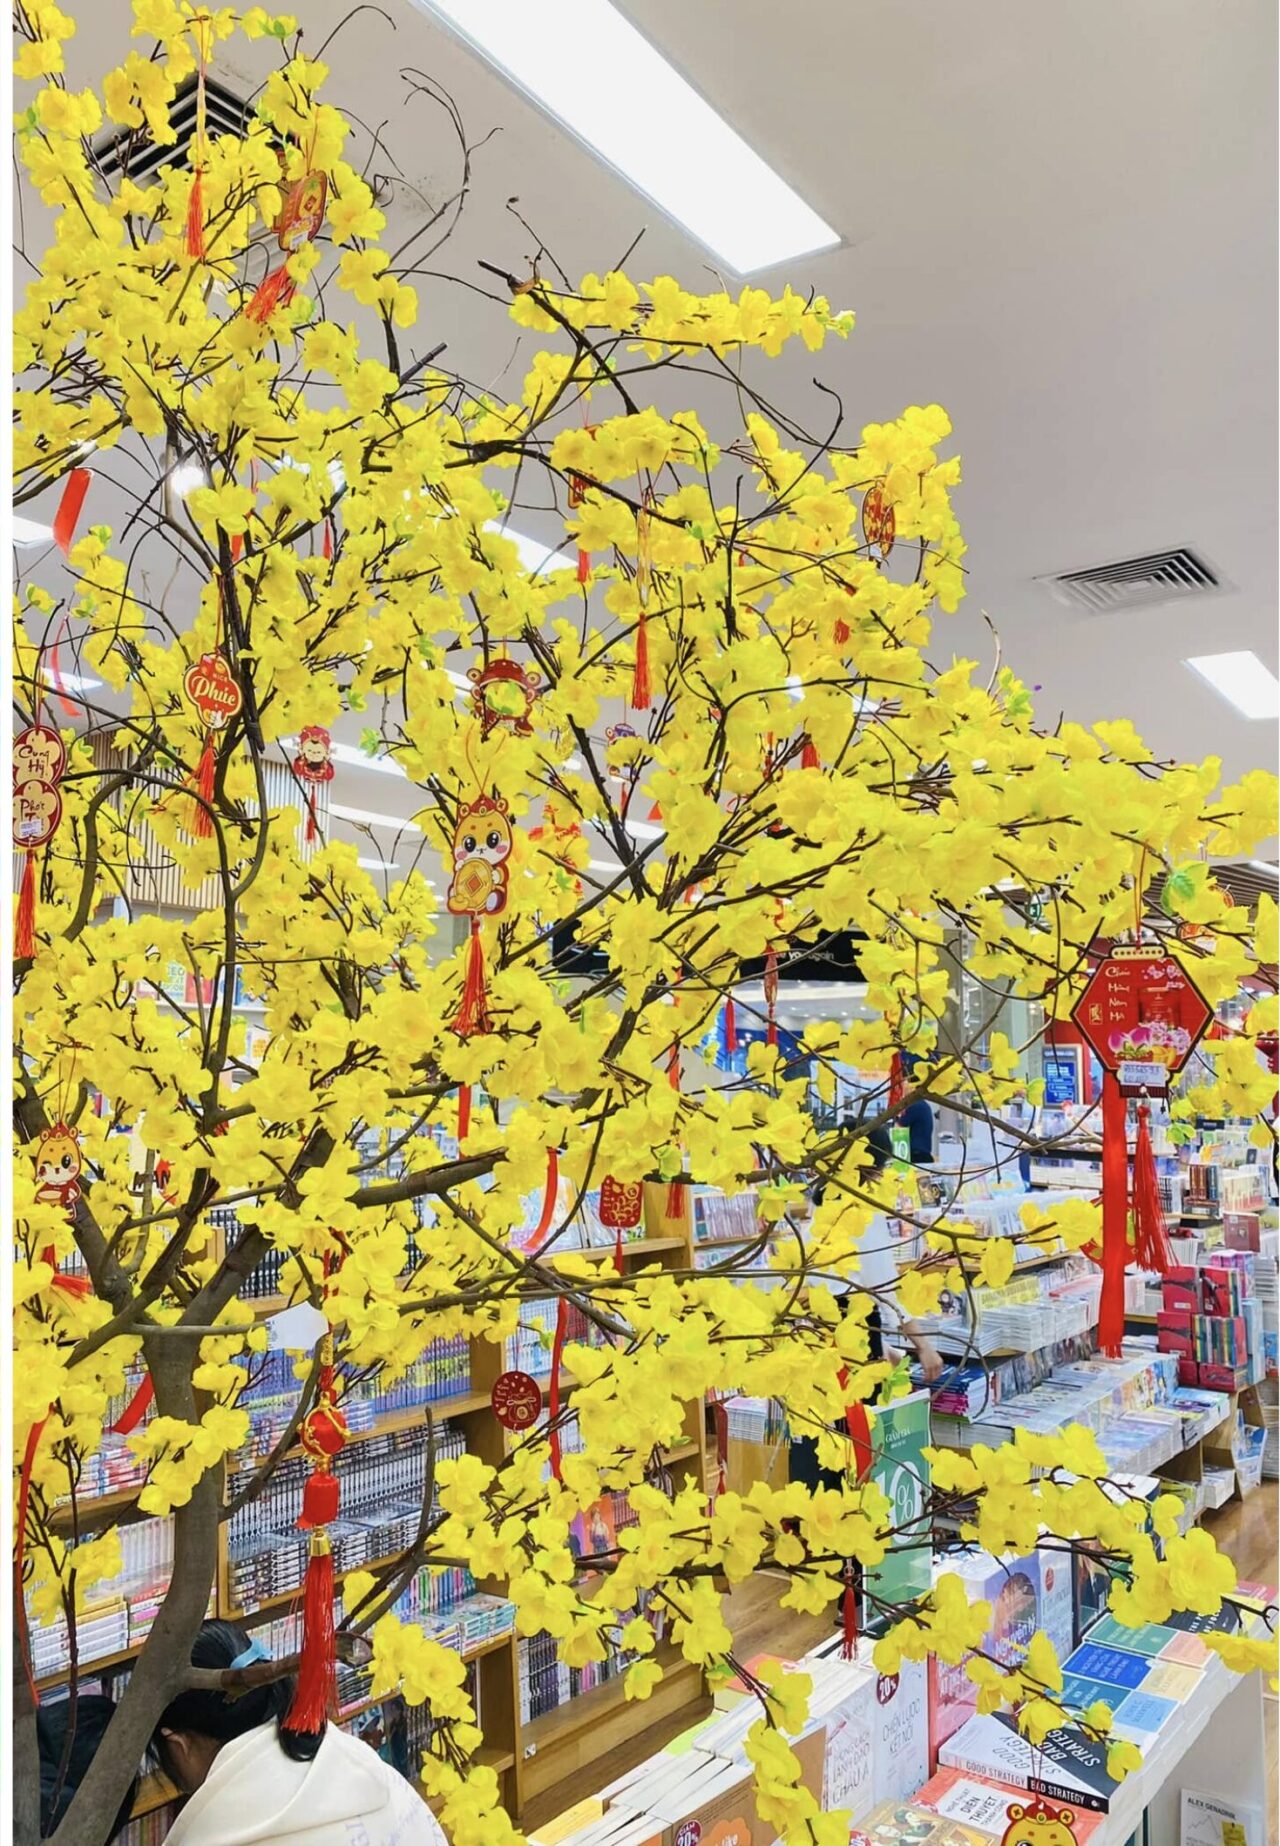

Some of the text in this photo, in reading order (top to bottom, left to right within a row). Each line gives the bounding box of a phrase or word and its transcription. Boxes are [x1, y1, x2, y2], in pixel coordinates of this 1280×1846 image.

[19, 745, 50, 766] Cung
[1036, 1742, 1068, 1761] BAD
[1046, 1729, 1101, 1767] STRATEG
[965, 1761, 1026, 1787] GOOD STRATEGY
[1047, 1785, 1086, 1805] STRATEGY
